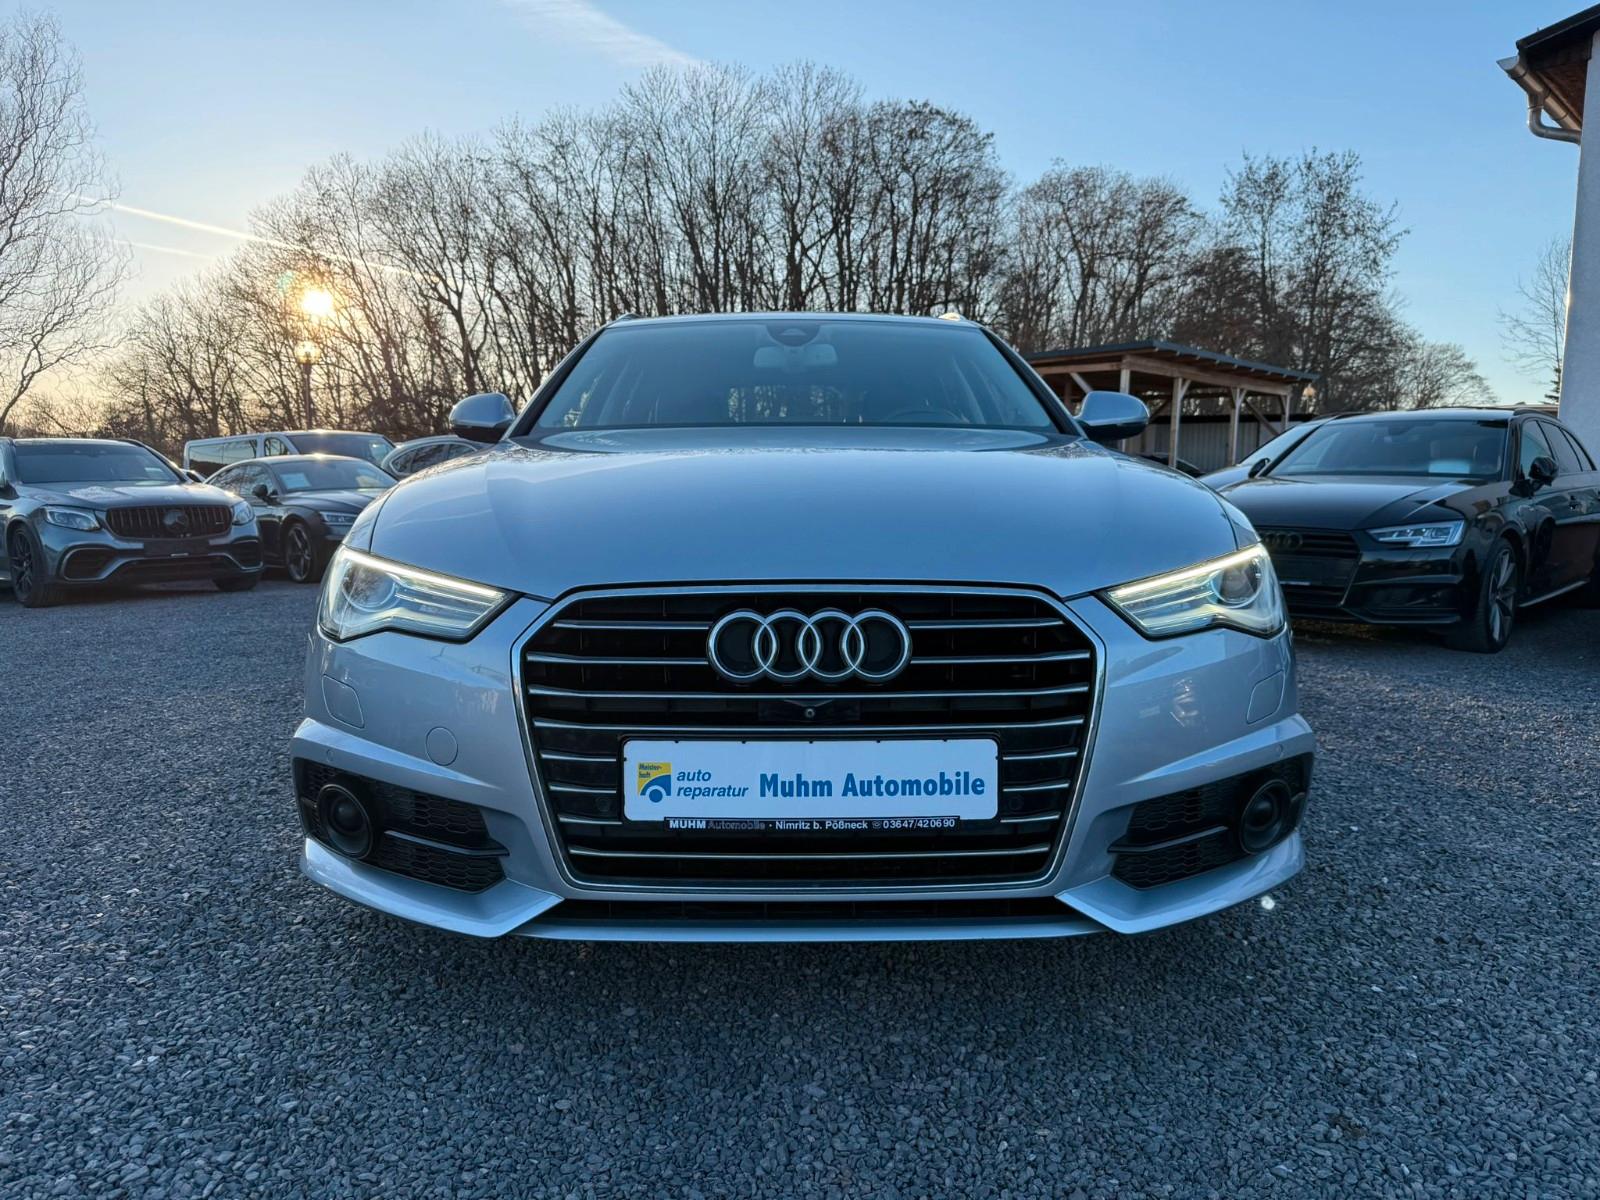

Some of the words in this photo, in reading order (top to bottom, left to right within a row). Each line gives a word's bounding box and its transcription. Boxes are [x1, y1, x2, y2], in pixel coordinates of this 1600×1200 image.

[676, 769, 712, 782] auto
[759, 773, 833, 798] Muhm
[841, 771, 985, 797] Automobile
[676, 785, 749, 799] reparatur
[669, 819, 706, 829] MUHM
[707, 819, 766, 830] Automobile
[775, 820, 811, 830] Nimritz
[825, 820, 868, 830] Pößneck
